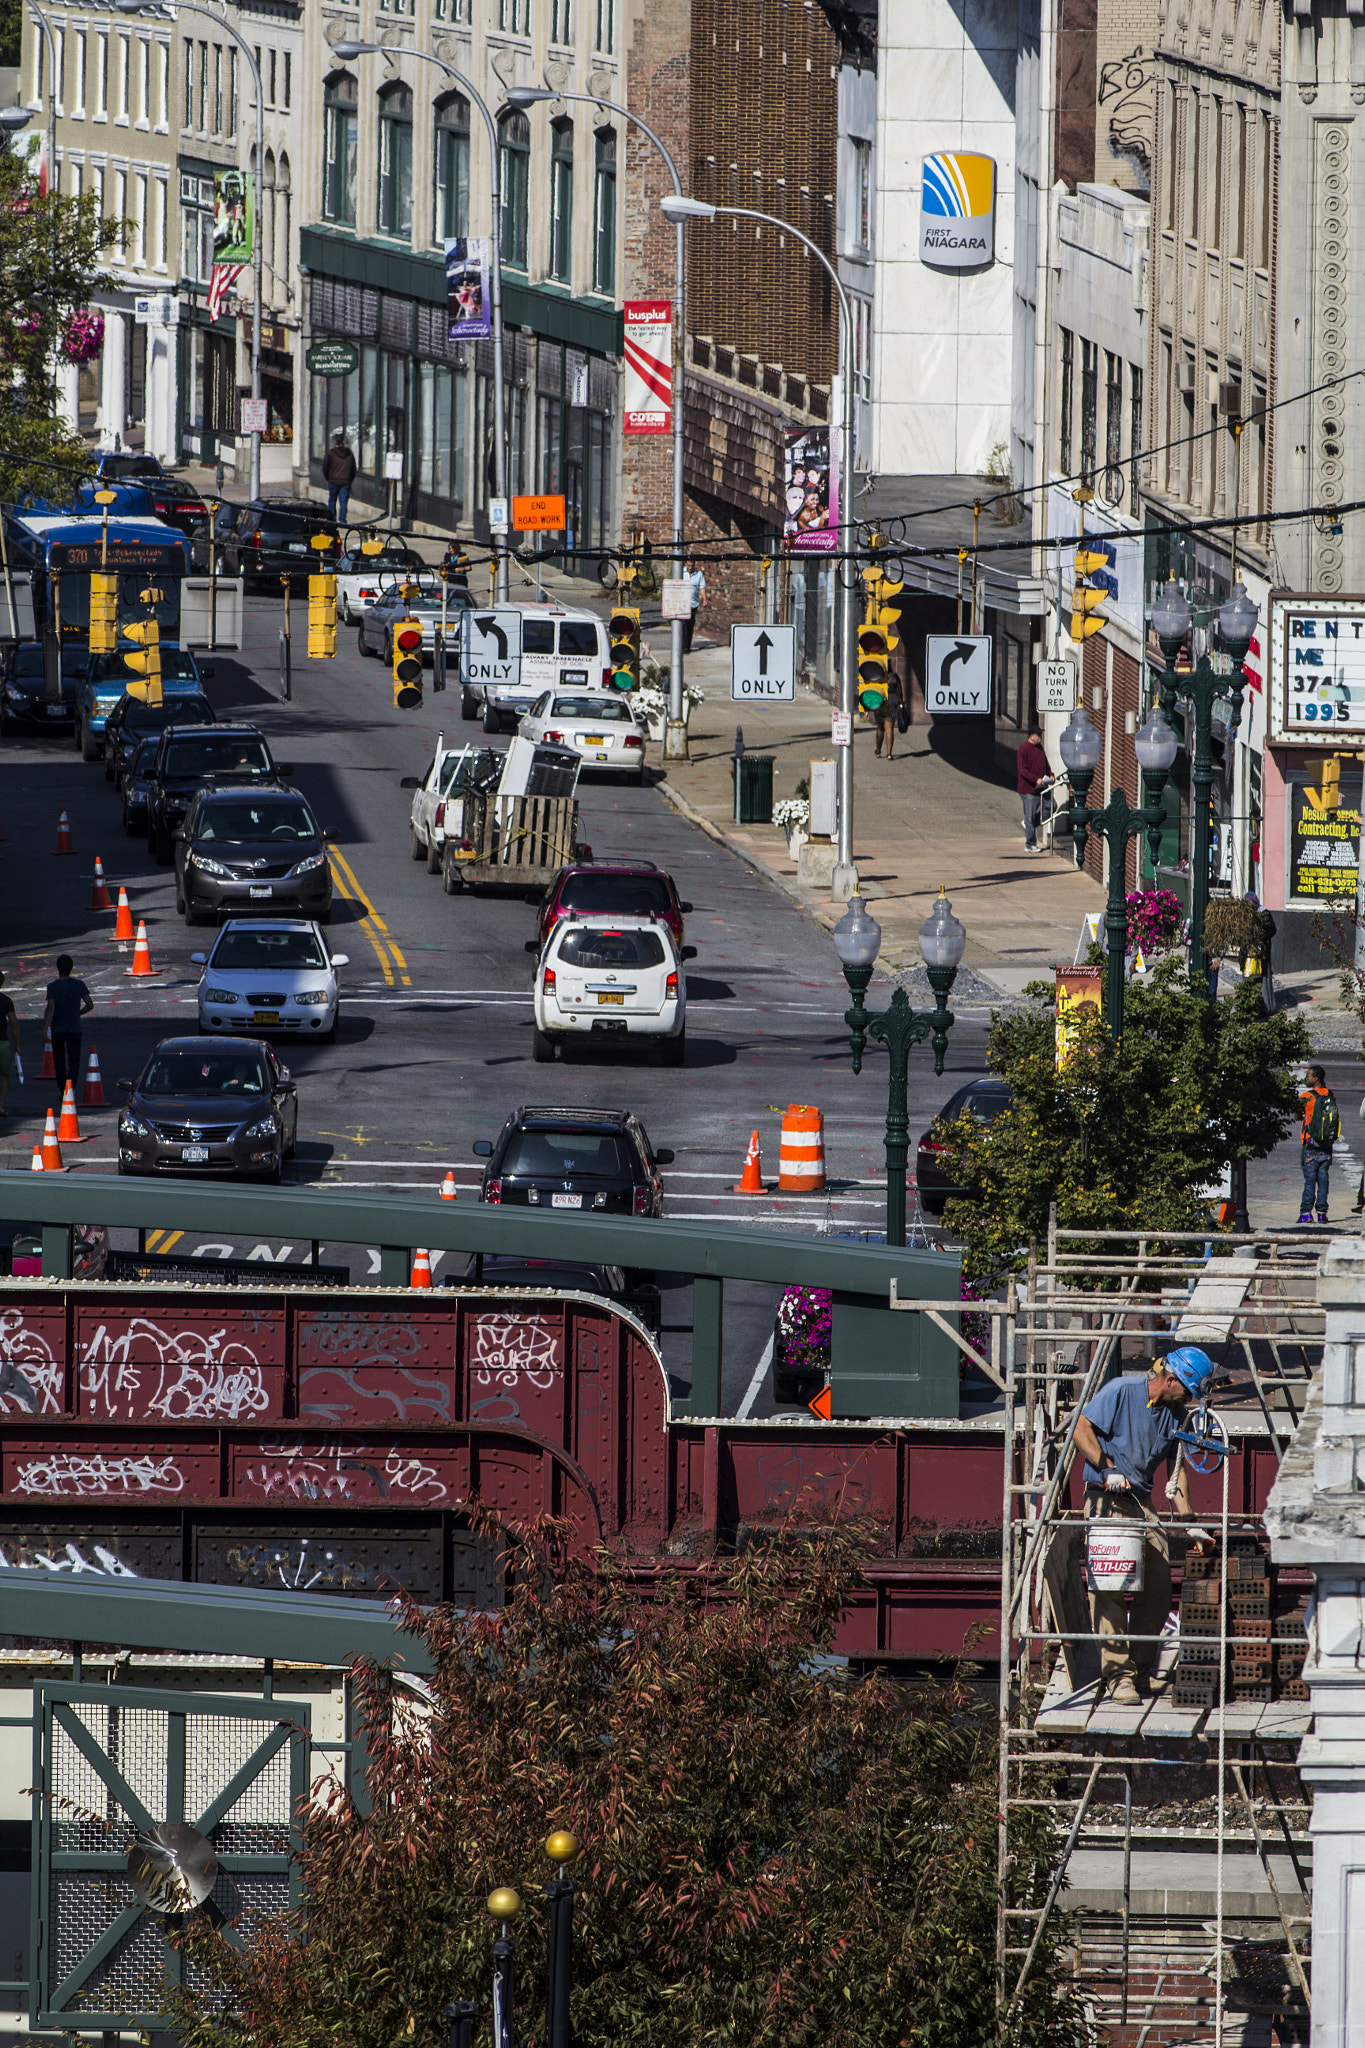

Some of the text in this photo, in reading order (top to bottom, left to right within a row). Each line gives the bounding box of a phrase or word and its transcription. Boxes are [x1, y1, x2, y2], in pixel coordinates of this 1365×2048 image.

[926, 228, 951, 237] FIRST
[924, 237, 987, 249] NIAGARA
[628, 309, 667, 323] busplus
[629, 412, 659, 422] CDTA
[831, 430, 839, 476] SOCIABLE
[531, 501, 546, 510] END
[518, 515, 561, 525] ROAD WORK
[68, 549, 88, 564] 370
[1295, 647, 1324, 666] ME
[469, 664, 512, 678] ONLY
[1048, 666, 1066, 676] NO
[742, 679, 786, 694] ONLY
[1045, 678, 1067, 686] TURN
[935, 691, 980, 706] ONLY
[1048, 699, 1065, 707] RED
[1296, 702, 1350, 722] 1995
[1302, 806, 1328, 821] Nestor
[1298, 820, 1348, 839] Contracting,
[1299, 876, 1357, 886] 518-631-0572
[1297, 885, 1315, 893] cell
[1088, 1544, 1121, 1554] ROFORM
[1088, 1561, 1135, 1572] ULTI-USE
